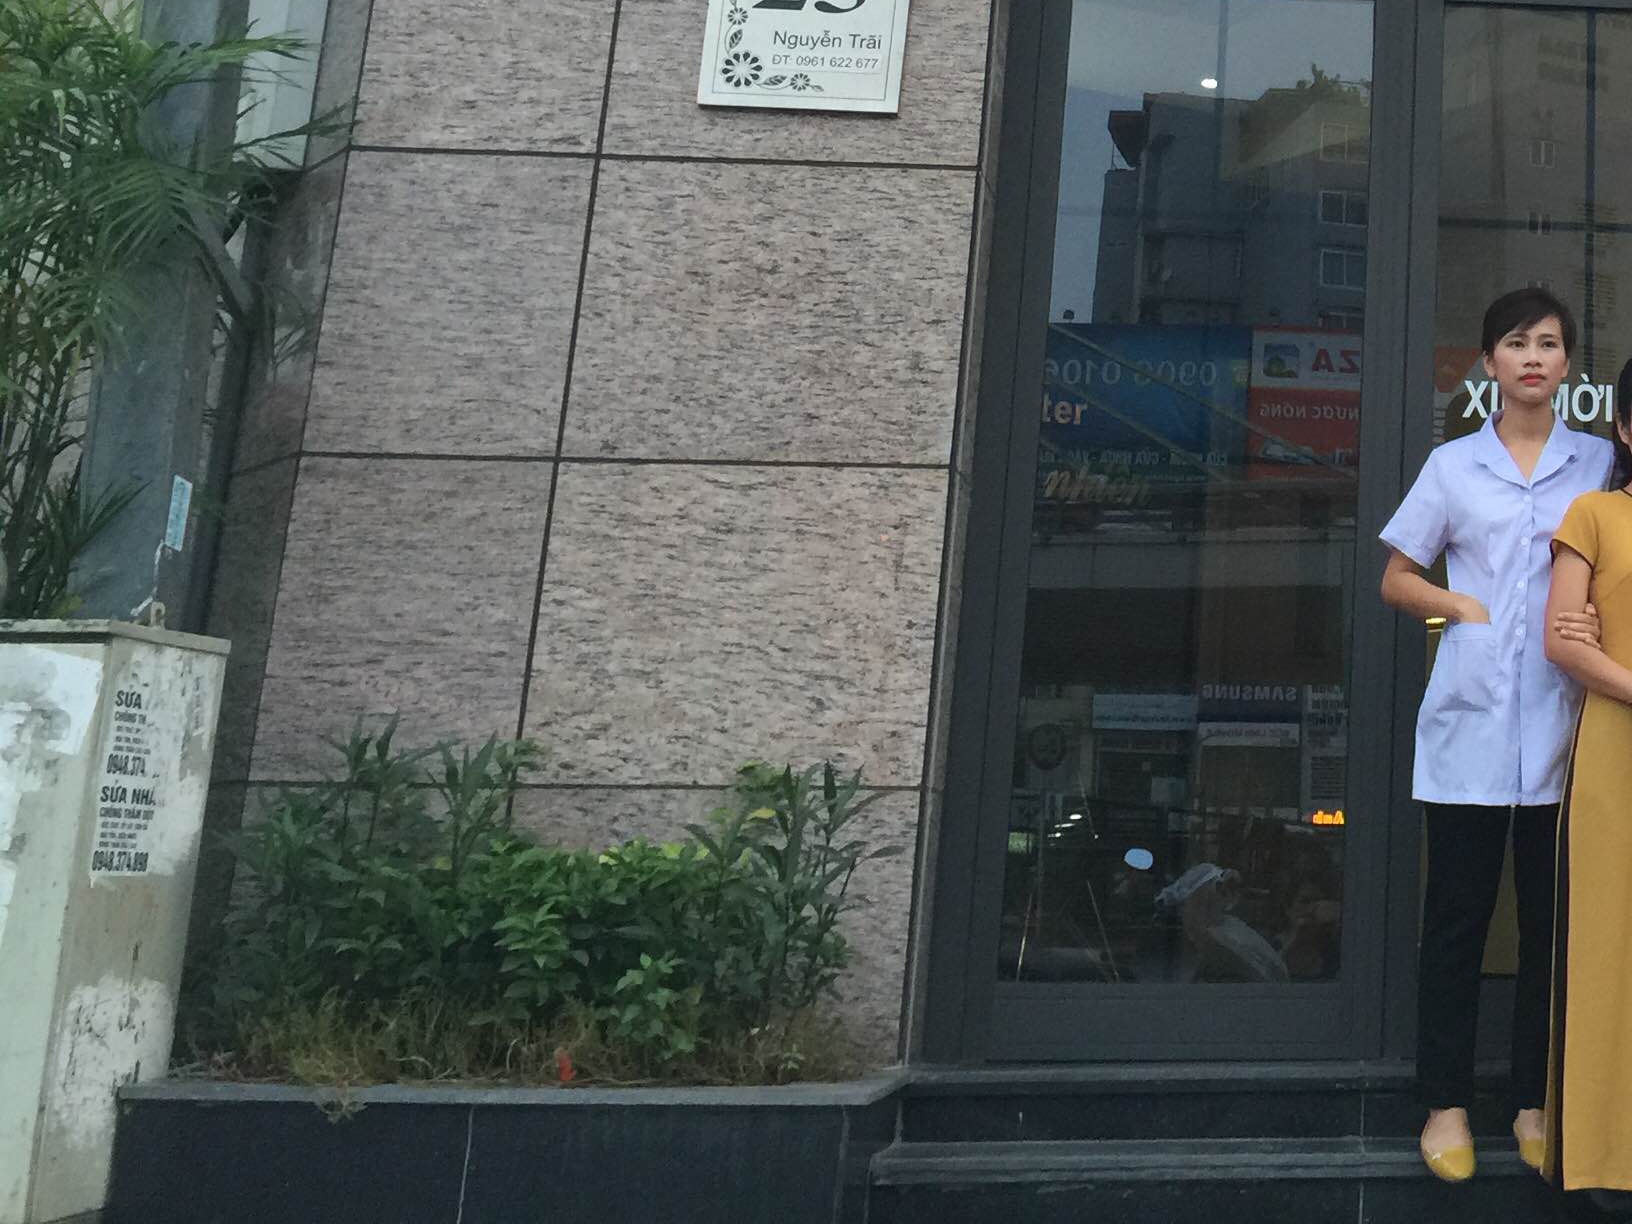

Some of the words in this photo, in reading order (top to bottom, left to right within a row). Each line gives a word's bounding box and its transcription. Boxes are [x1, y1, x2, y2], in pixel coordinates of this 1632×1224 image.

[773, 30, 842, 51] Nguyễn
[849, 33, 882, 50] Trãi
[796, 55, 826, 67] 0961
[829, 56, 853, 68] 622
[855, 57, 879, 69] 677
